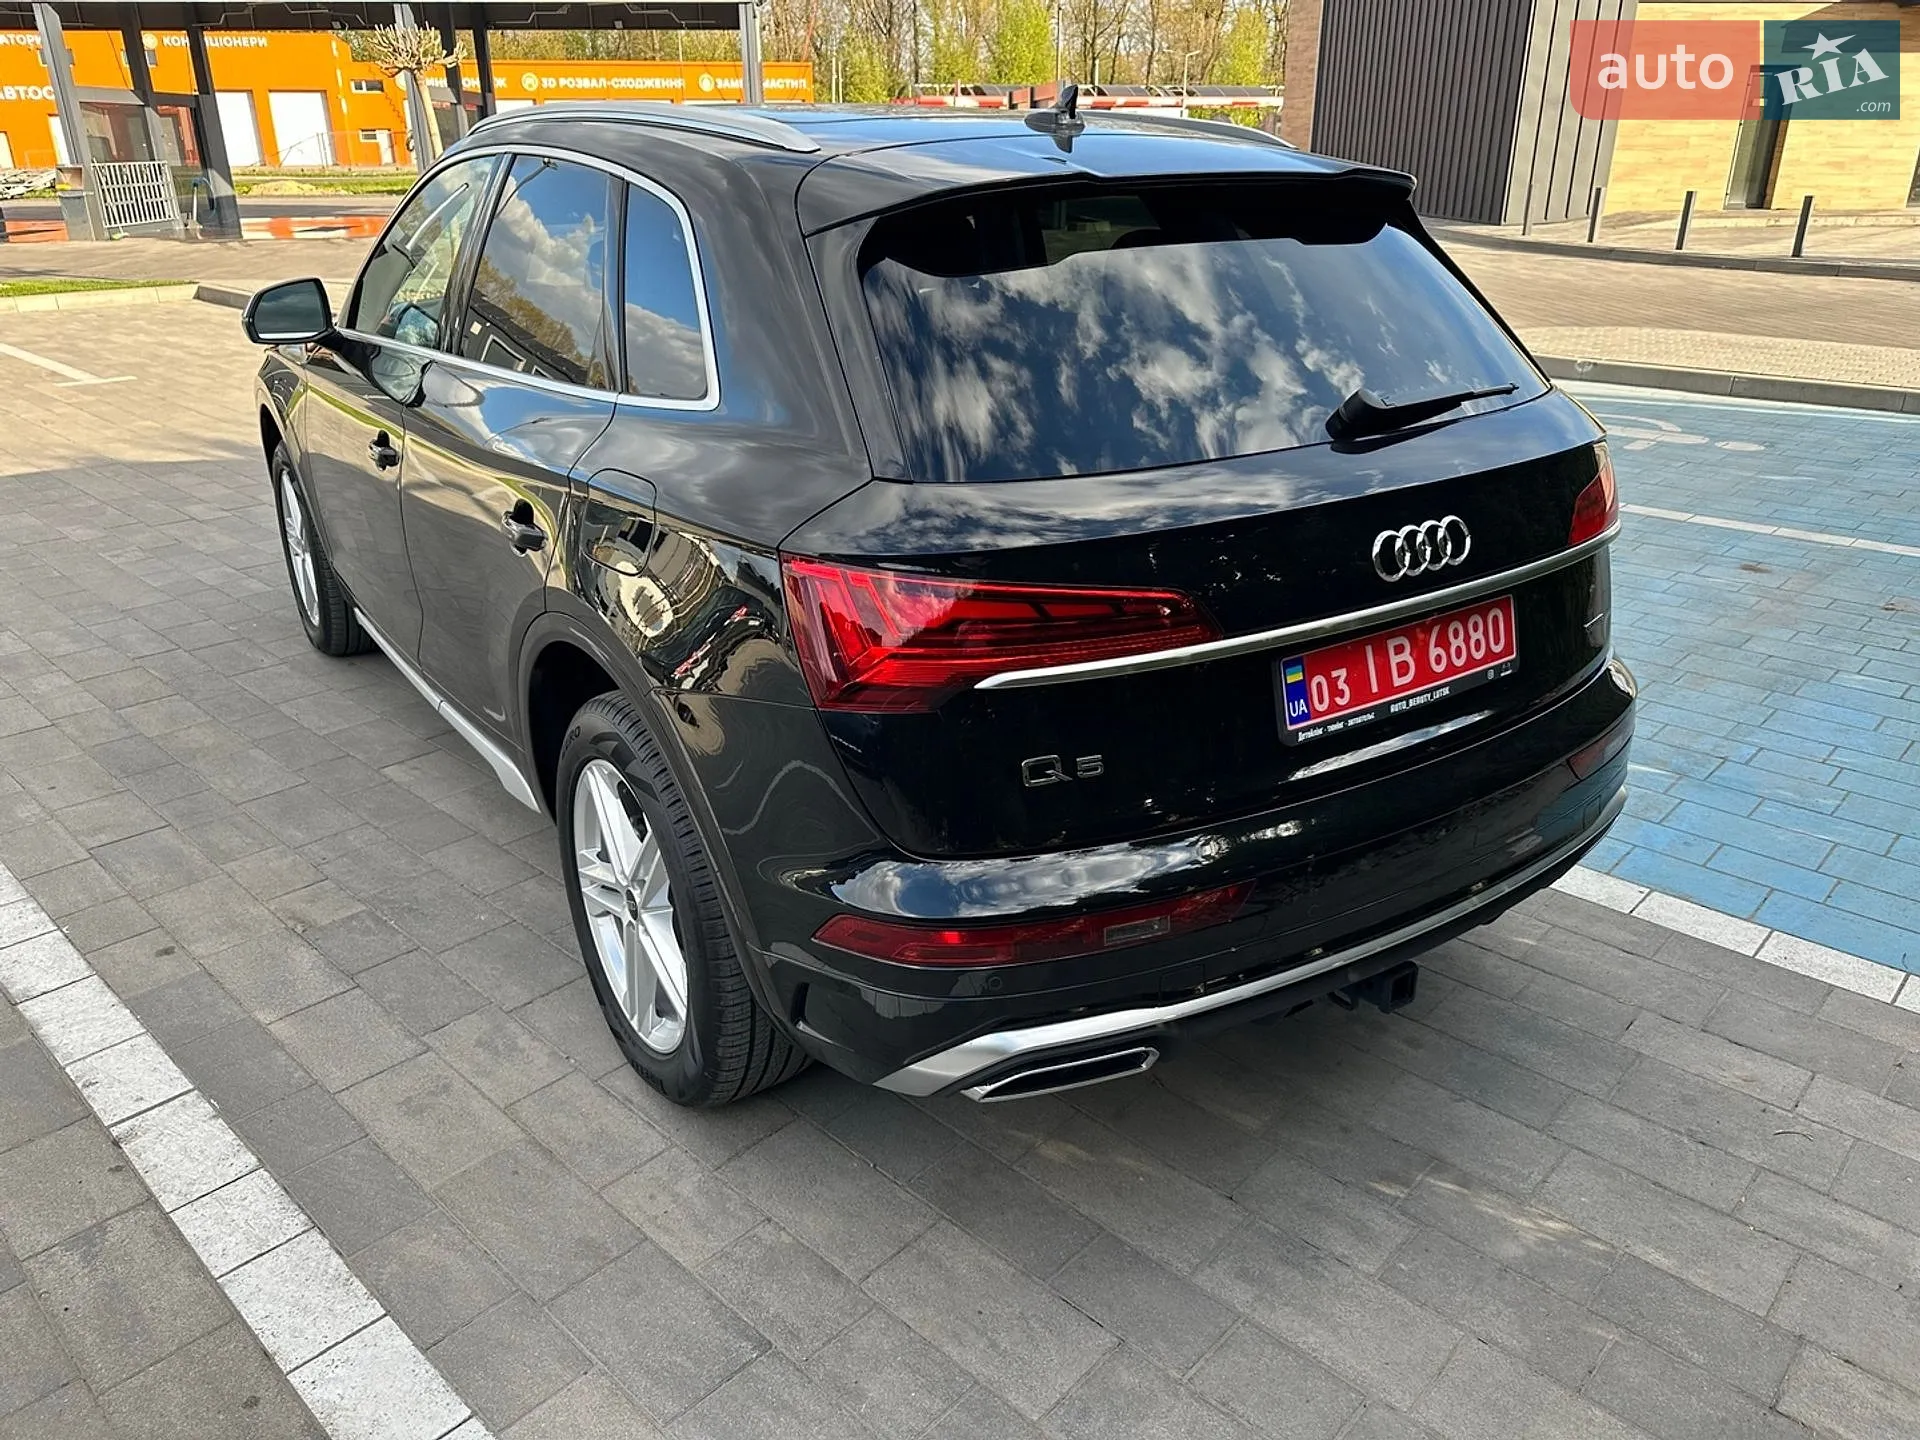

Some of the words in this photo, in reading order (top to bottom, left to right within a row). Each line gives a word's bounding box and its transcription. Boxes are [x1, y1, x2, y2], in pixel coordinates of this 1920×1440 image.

[162, 35, 267, 47] КОНЦІОНЕРИ
[1310, 667, 1351, 713] 03
[1364, 635, 1416, 693] IB
[1428, 607, 1507, 674] 6880
[1289, 698, 1308, 717] UA
[1021, 754, 1104, 787] Q5
